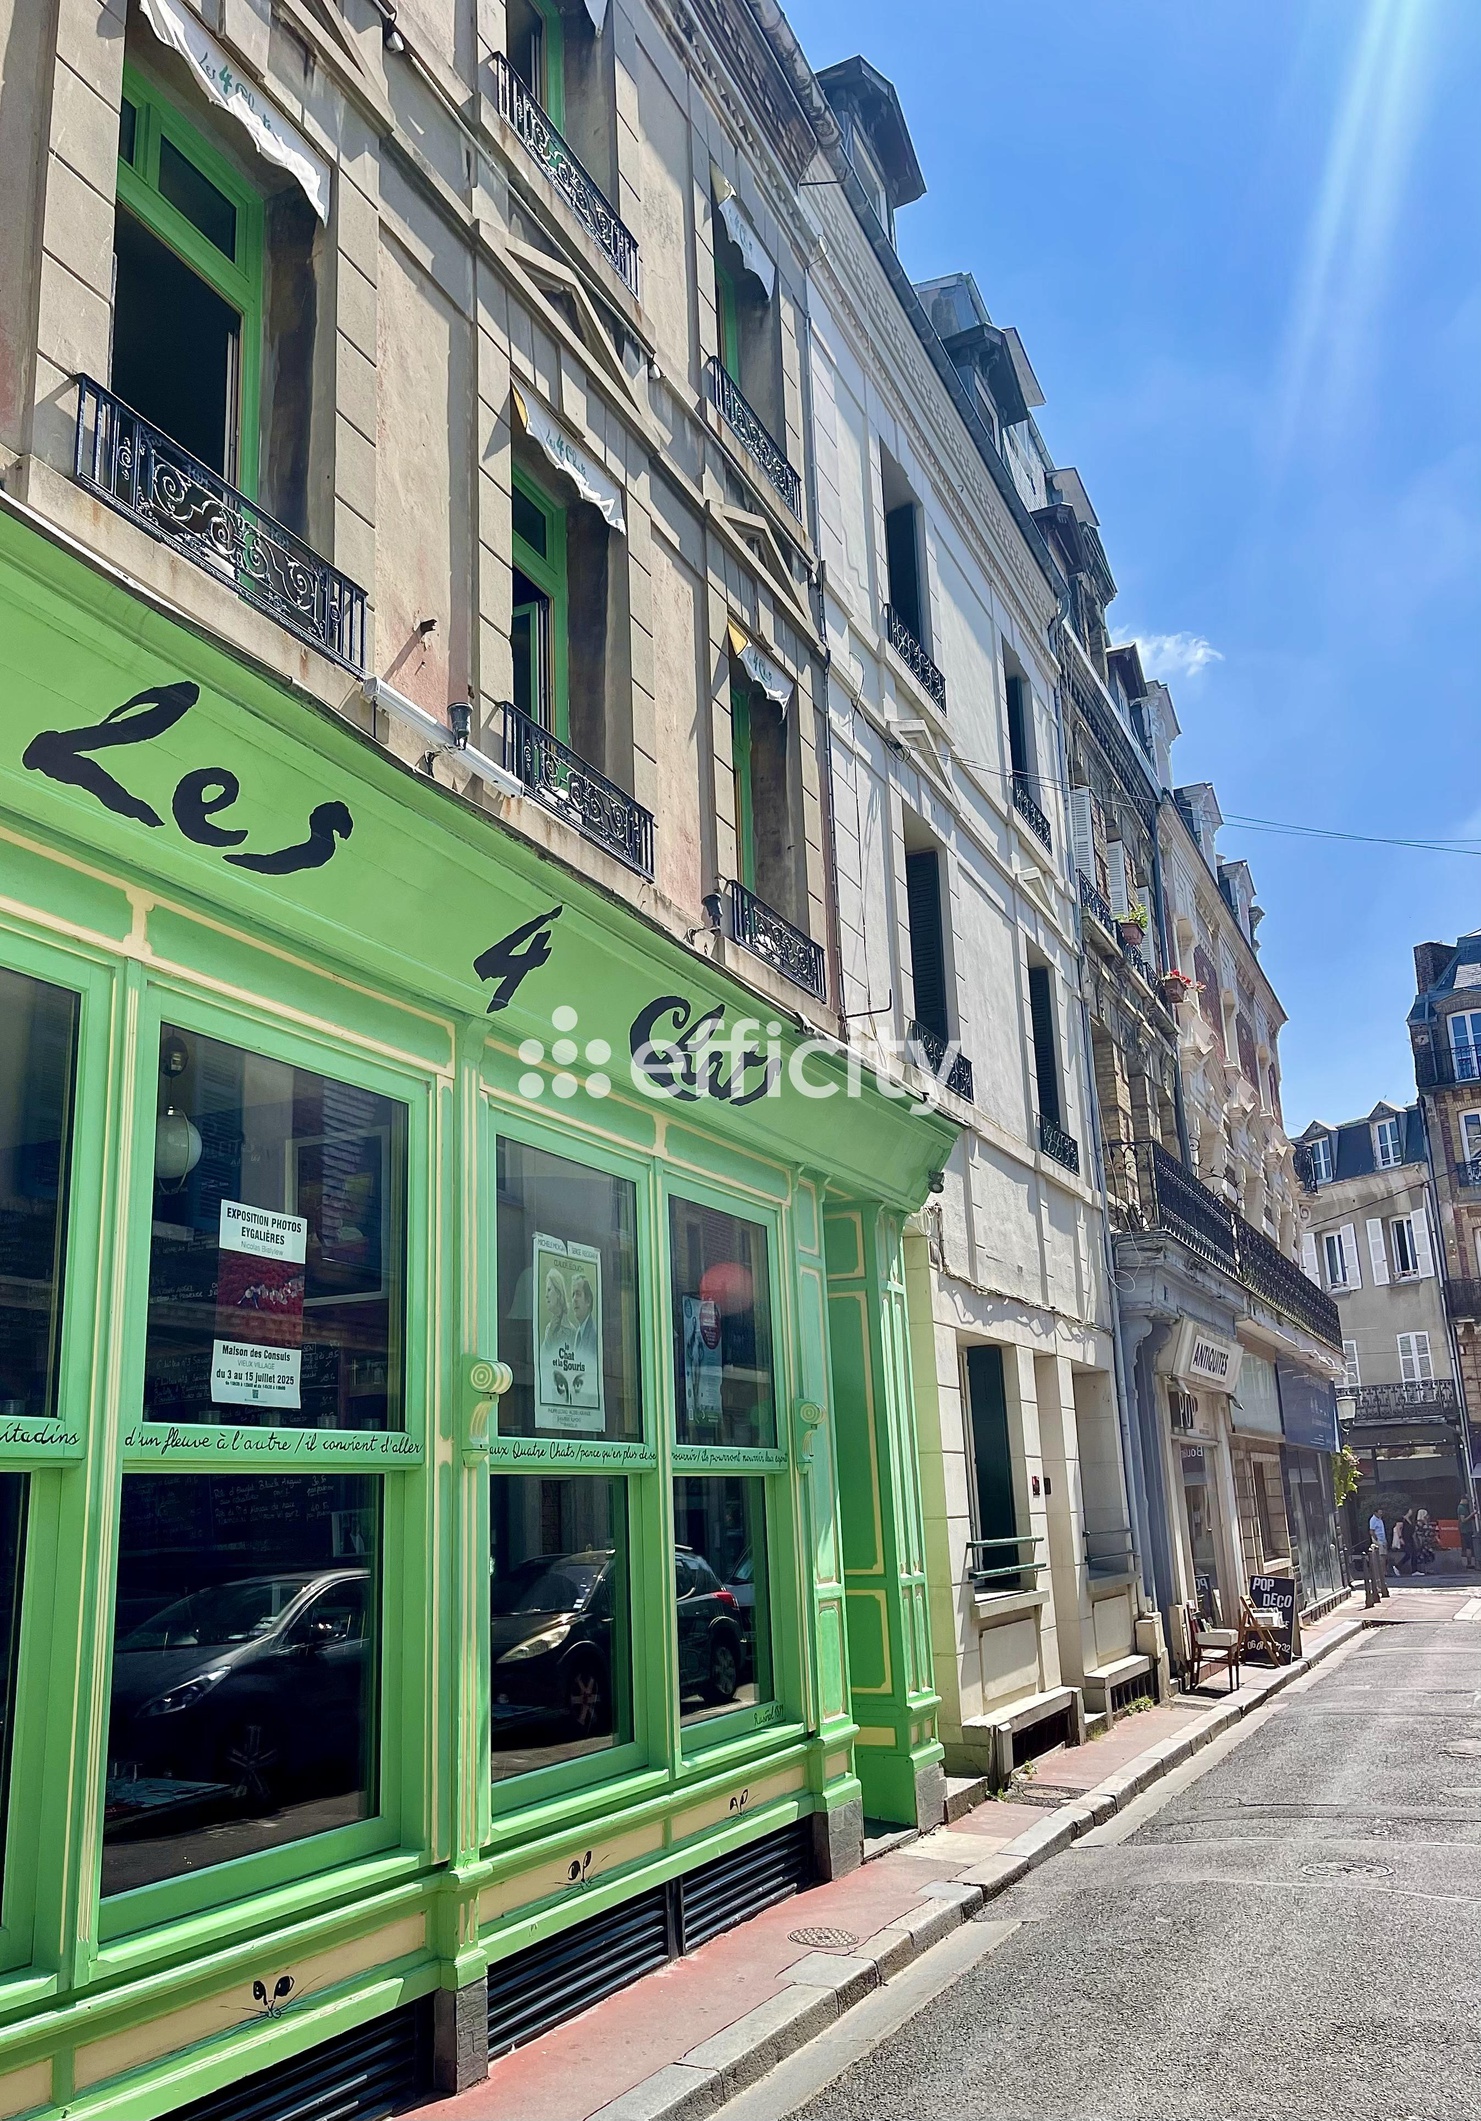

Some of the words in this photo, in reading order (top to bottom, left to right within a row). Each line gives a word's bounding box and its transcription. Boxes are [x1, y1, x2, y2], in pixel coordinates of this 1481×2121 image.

[218, 64, 233, 95] 4
[556, 433, 565, 458] 4
[22, 680, 354, 876] Les
[473, 904, 564, 1014] 4
[628, 995, 783, 1106] Chats
[226, 1206, 269, 1227] EXPOSITION
[271, 1218, 302, 1233] PHOTOS
[241, 1226, 285, 1245] EYGALIÈRES
[222, 1344, 248, 1357] Maison
[250, 1348, 262, 1359] des
[263, 1349, 291, 1361] Consuls
[558, 1347, 575, 1360] Chat
[564, 1342, 569, 1350] le
[237, 1359, 253, 1367] VIEUX
[254, 1361, 275, 1370] VILLAGE
[563, 1360, 585, 1372] Souris
[216, 1368, 226, 1378] du
[227, 1369, 232, 1379] 3
[233, 1372, 243, 1380] au
[245, 1371, 254, 1382] 15
[254, 1372, 276, 1384] juillet
[277, 1374, 294, 1385] 2025
[124, 1426, 162, 1447] d'un
[161, 1426, 213, 1455] fleuve
[216, 1432, 229, 1450] à
[231, 1430, 291, 1451] l'autre
[322, 1435, 378, 1451] convient
[380, 1435, 424, 1454] d'aller
[489, 1445, 508, 1460] aux
[512, 1441, 547, 1460] Quatre
[549, 1441, 575, 1460] Chats
[602, 1447, 621, 1464] qu'en
[622, 1446, 637, 1465] plus
[1252, 1577, 1275, 1592] POP
[1262, 1593, 1293, 1608] DECO
